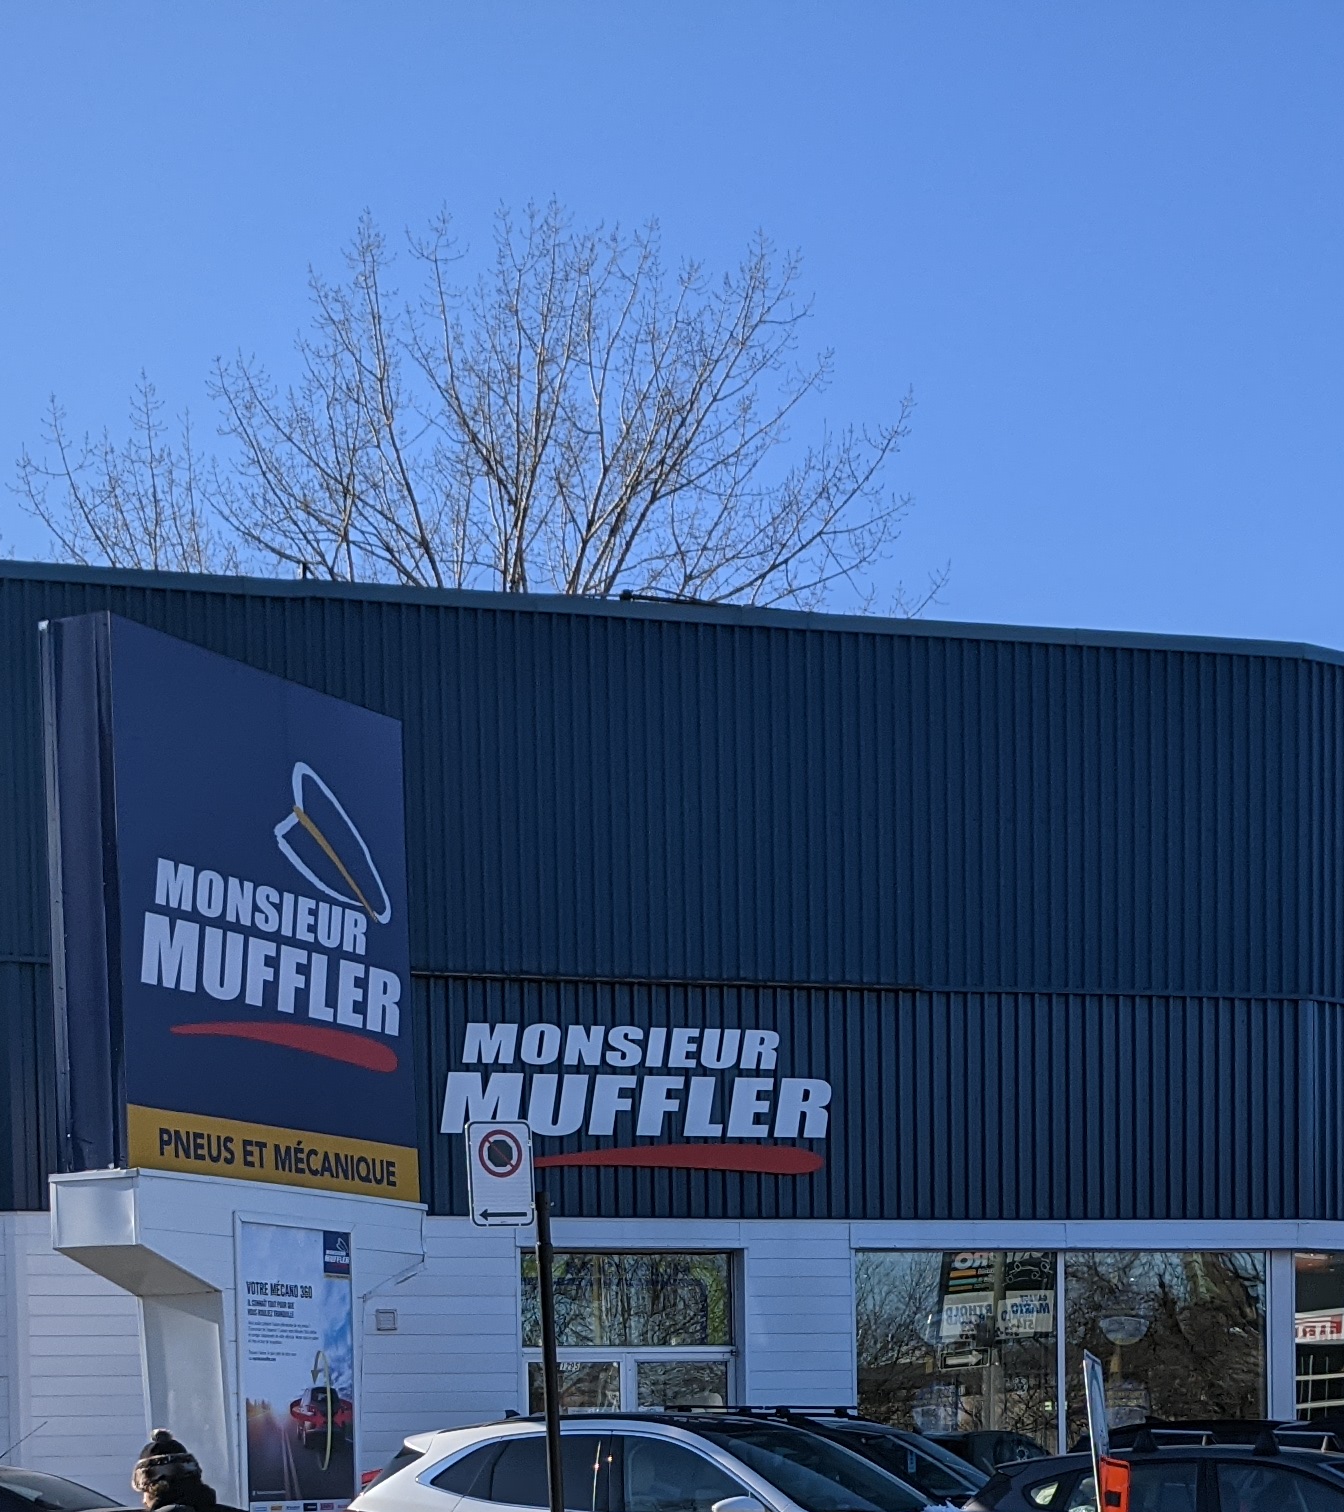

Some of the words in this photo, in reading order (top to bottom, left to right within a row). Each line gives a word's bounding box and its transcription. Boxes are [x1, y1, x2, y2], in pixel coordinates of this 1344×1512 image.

[155, 857, 367, 956] MONSIEUR
[140, 911, 401, 1037] MUFFLER
[462, 1022, 780, 1070] MONSIEUR
[440, 1071, 832, 1139] MUFFLER
[159, 1127, 236, 1166] PNEUS
[242, 1138, 268, 1169] ET
[274, 1140, 397, 1187] MÉCANIQUE
[246, 1281, 269, 1296] VOTRE
[270, 1281, 299, 1298] MÉCANO
[300, 1285, 313, 1299] 360
